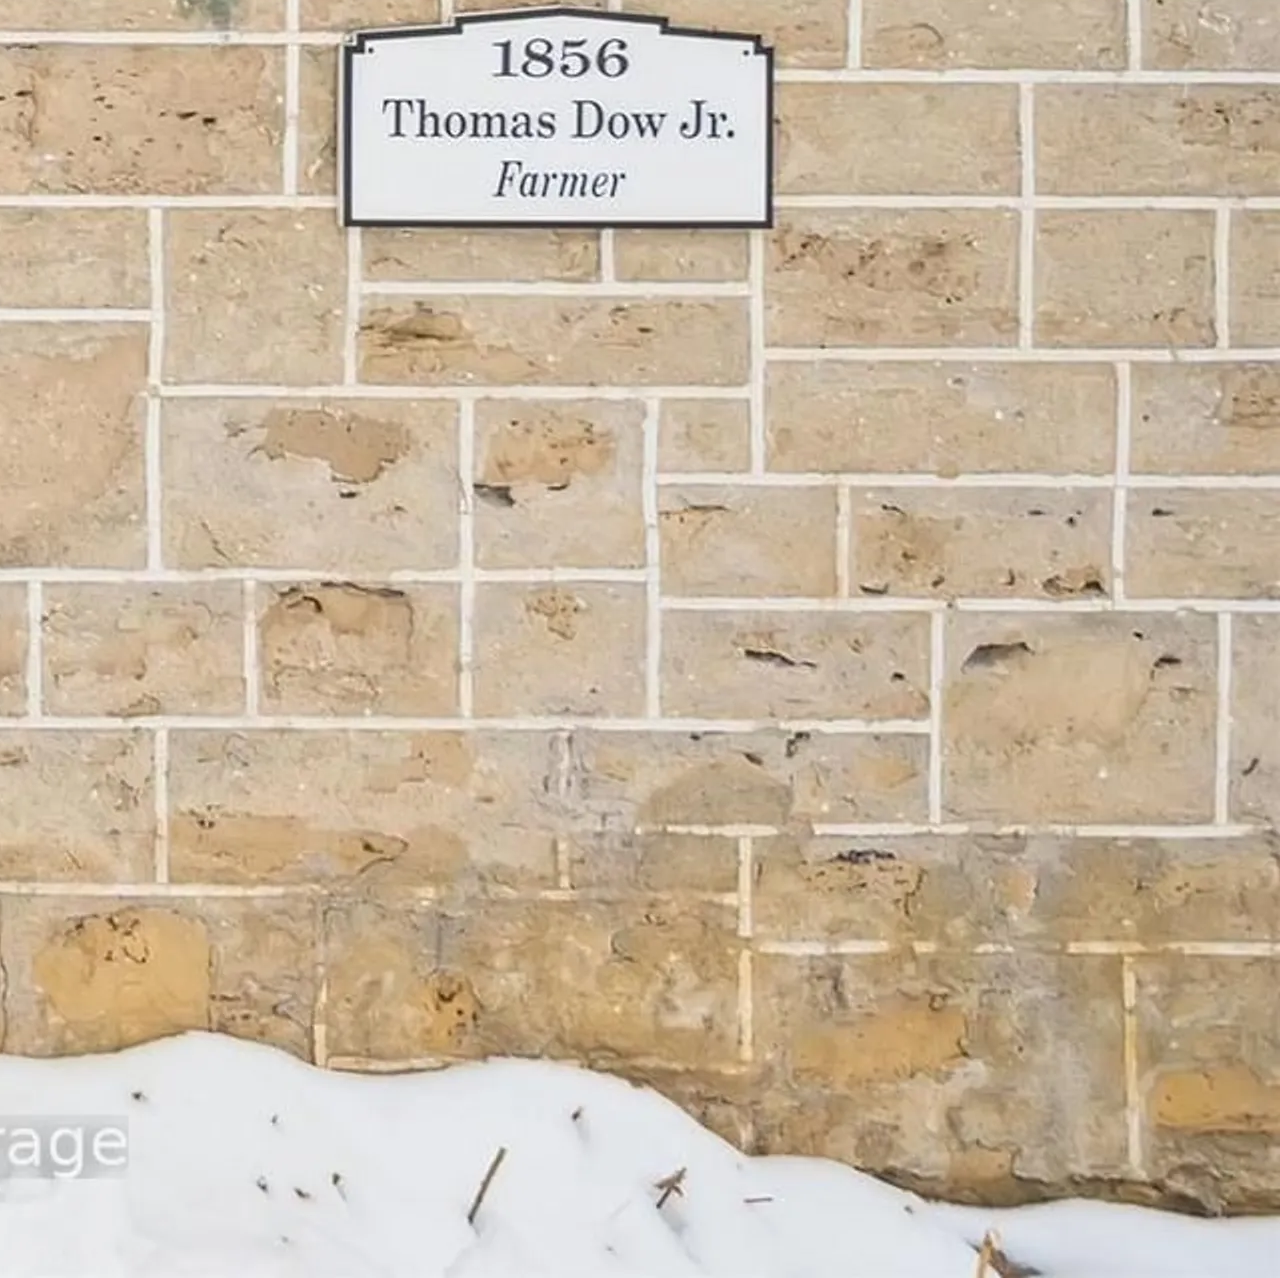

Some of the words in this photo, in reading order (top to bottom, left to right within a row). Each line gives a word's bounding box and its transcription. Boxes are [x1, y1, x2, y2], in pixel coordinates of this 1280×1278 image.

[492, 38, 629, 78] 1856
[381, 98, 557, 139] Thomas
[571, 99, 667, 139] Dow
[679, 99, 736, 140] Jr.
[492, 159, 627, 198] Farmer
